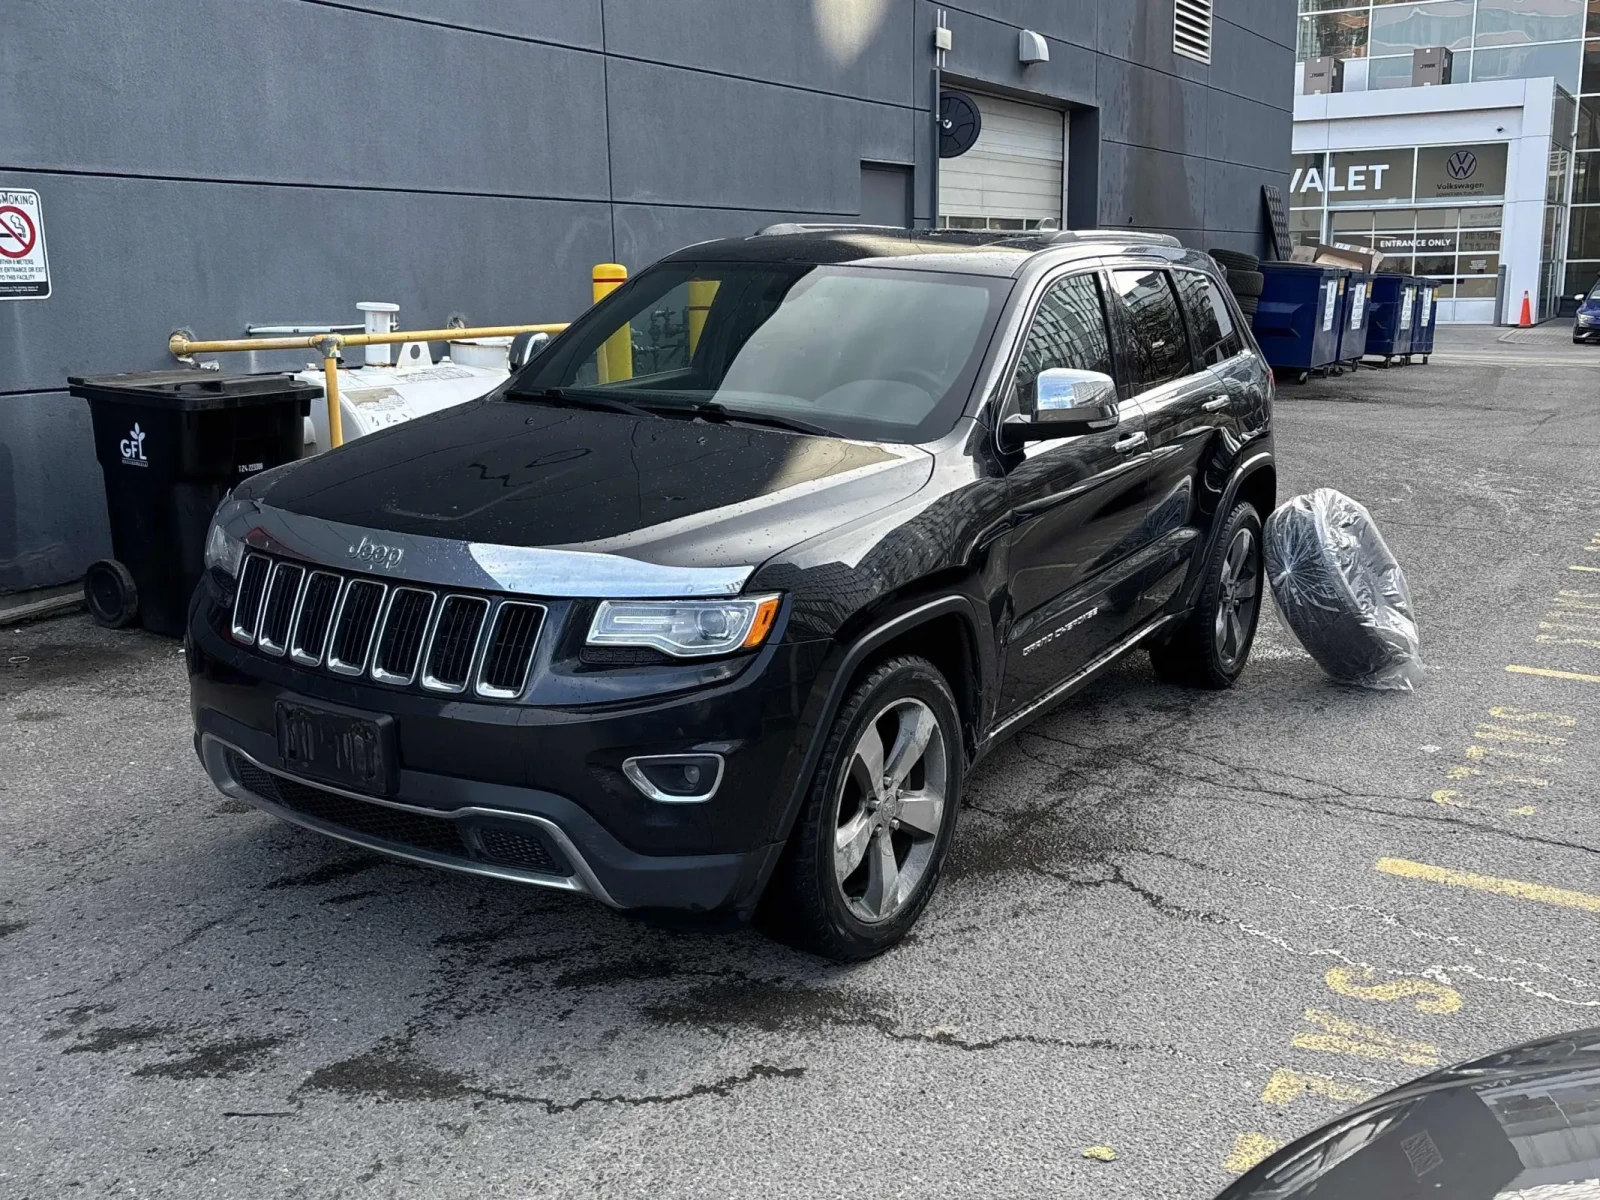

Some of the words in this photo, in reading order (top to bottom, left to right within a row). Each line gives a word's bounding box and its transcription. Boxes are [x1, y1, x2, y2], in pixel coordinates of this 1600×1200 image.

[1436, 182, 1485, 190] Volkswagen
[0, 192, 34, 206] MOKING
[1380, 239, 1427, 248] ENTRANCE
[1428, 238, 1452, 247] ONLY
[120, 432, 147, 460] GFL
[345, 535, 404, 571] Jeep
